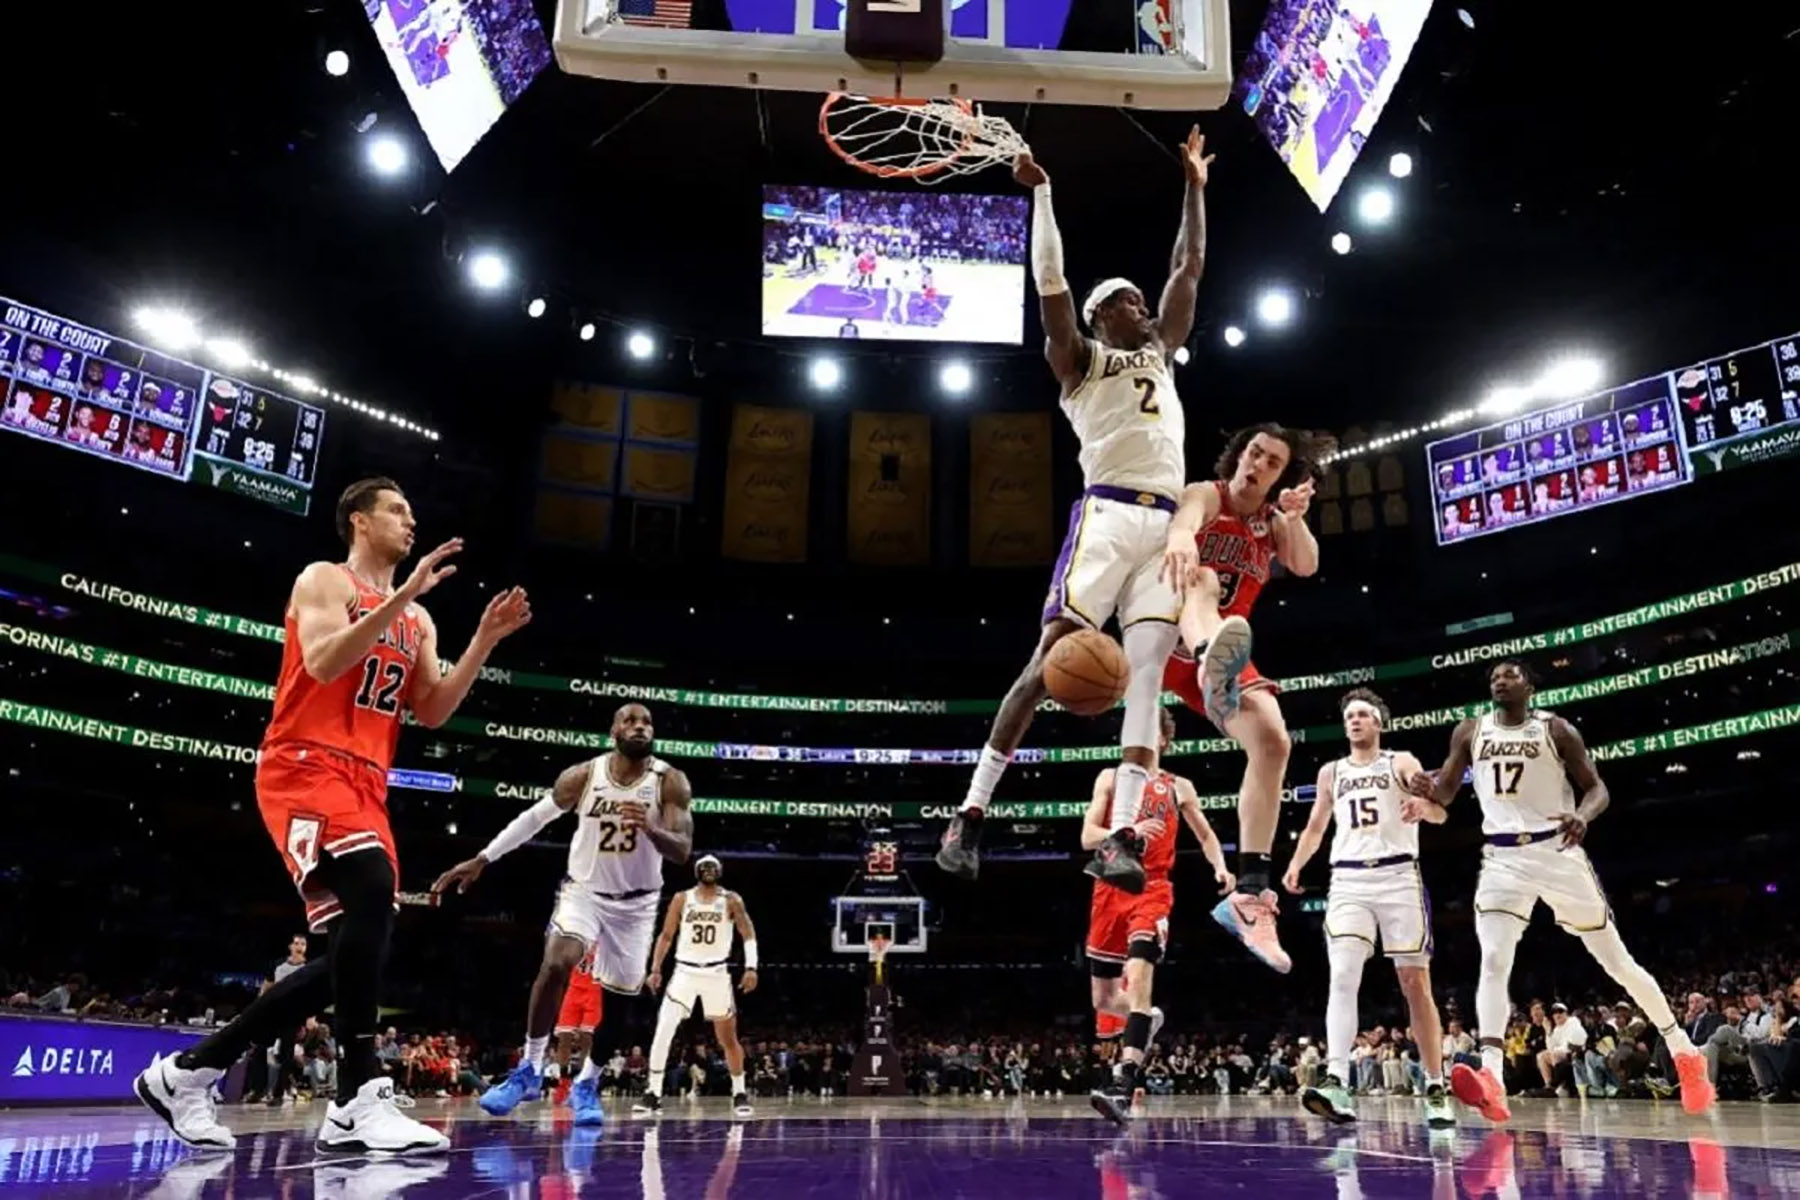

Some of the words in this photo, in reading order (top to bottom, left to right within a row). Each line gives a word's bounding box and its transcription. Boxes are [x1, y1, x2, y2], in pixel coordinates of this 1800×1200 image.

[5, 307, 31, 328] ON
[30, 315, 61, 339] THE
[59, 326, 112, 356] COURT
[61, 352, 73, 370] 2
[119, 371, 131, 388] 2
[50, 396, 62, 412] 2
[174, 390, 185, 406] 2
[1134, 377, 1159, 415] 2
[1505, 421, 1521, 440] ON
[1523, 417, 1544, 435] THE
[61, 573, 198, 623] CALIFORNIA'S
[204, 611, 232, 630] #1
[1432, 636, 1547, 669] CALIFORNIA'S
[1553, 626, 1577, 646] #1
[1582, 583, 1736, 638] ENTERTAINMENT
[0, 623, 95, 662] FORNIA'S
[102, 653, 130, 671] #1
[135, 659, 277, 700] ENTERTAINME
[1529, 667, 1653, 708] TERTAINMENT
[1658, 632, 1790, 680] DESTINATION
[354, 655, 405, 716] 12
[1280, 666, 1375, 691] ESTINATION
[570, 679, 678, 702] CALIFORNIA'S
[684, 692, 703, 705] #1
[710, 694, 841, 713] ENTERTAINMENT
[845, 699, 947, 715] DESTINATION
[0, 699, 127, 743] RTAINMENT
[1643, 734, 1667, 751] #1
[1673, 704, 1800, 747] ENTERTAINM
[485, 722, 600, 748] CALIFORNIA'S
[1478, 739, 1540, 762] LAKERS
[1339, 774, 1389, 797] LAKERS
[1492, 762, 1524, 795] 17
[688, 798, 780, 816] RTAINMENT
[786, 801, 892, 818] DESTINATION
[1033, 803, 1052, 818] #1
[1348, 797, 1378, 829] 15
[598, 820, 637, 852] 23
[869, 853, 894, 873] 23
[685, 909, 722, 923] LAKERS
[692, 924, 716, 945] 30
[41, 1047, 112, 1075] DELTA
